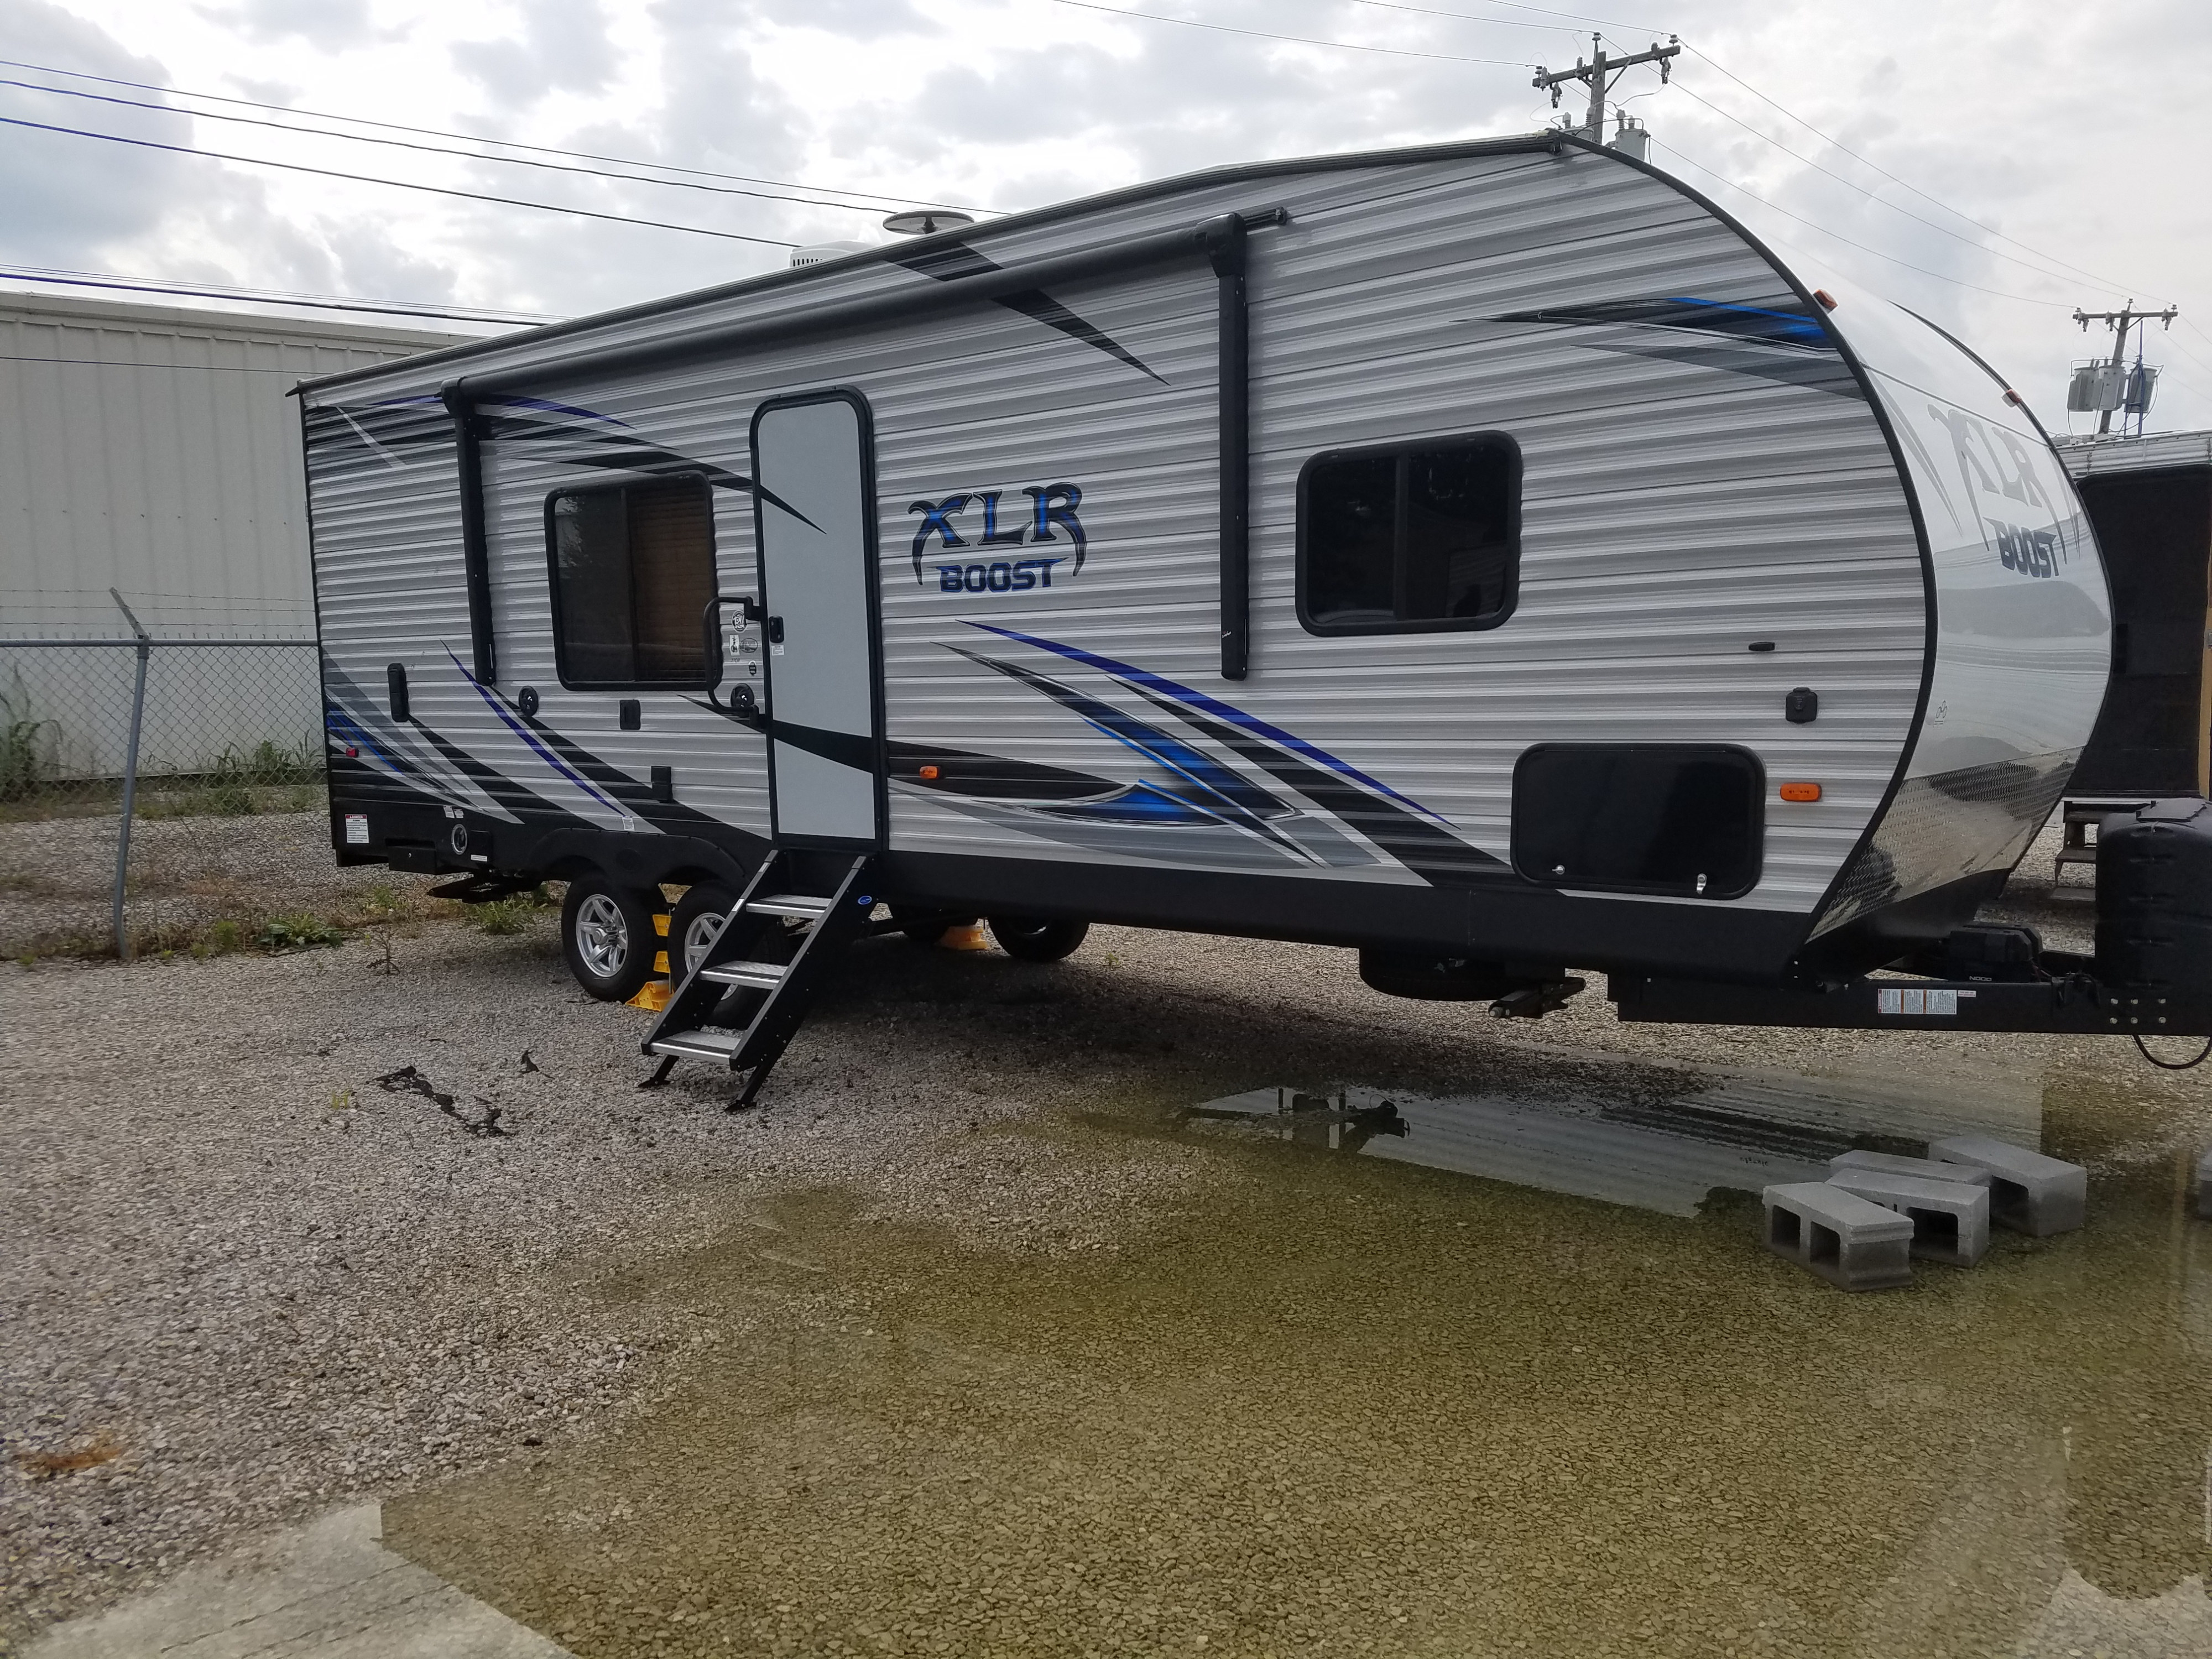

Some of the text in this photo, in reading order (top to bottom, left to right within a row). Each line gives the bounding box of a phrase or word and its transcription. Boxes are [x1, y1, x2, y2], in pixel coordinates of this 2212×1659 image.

[1927, 404, 2067, 565] XLR
[907, 482, 1087, 585] XLR
[1983, 518, 2059, 578] BOOST
[926, 557, 1069, 592] BOOST
